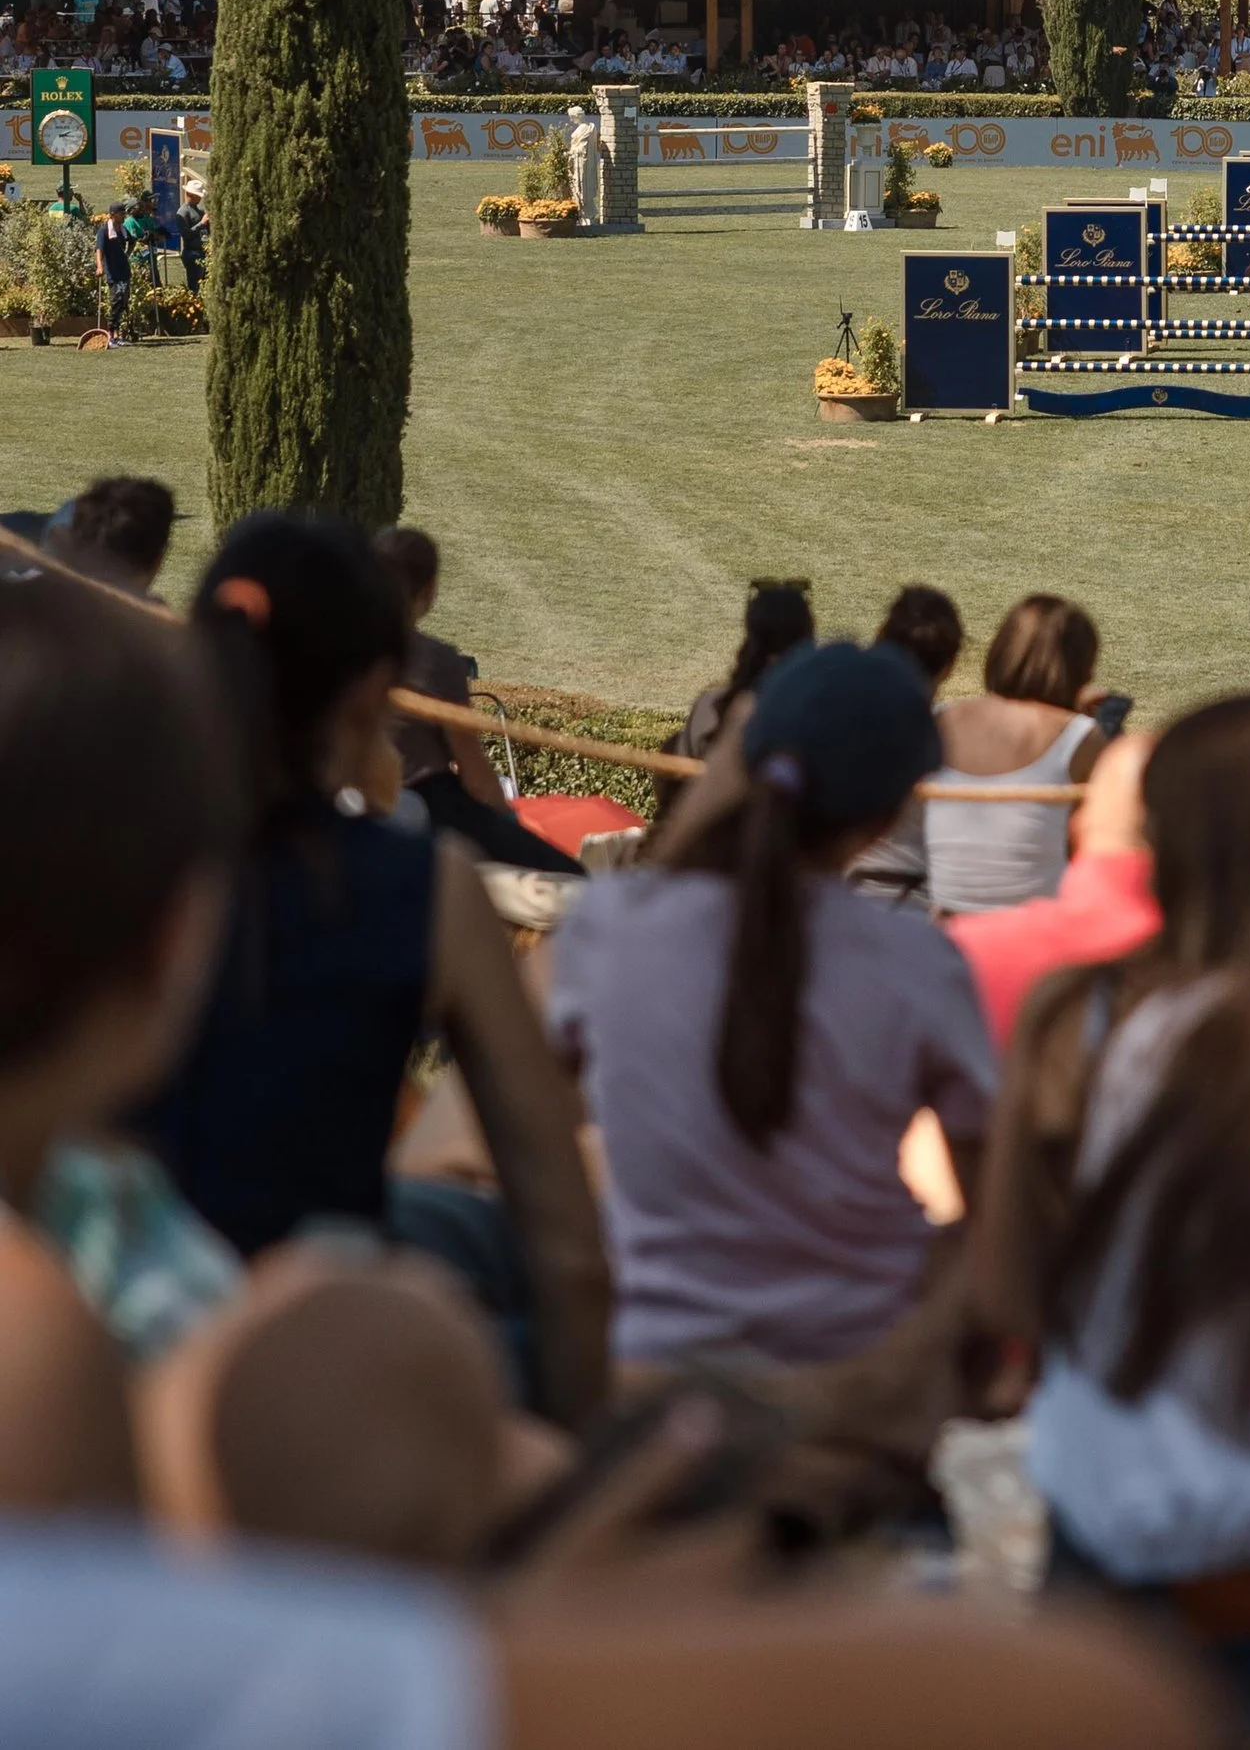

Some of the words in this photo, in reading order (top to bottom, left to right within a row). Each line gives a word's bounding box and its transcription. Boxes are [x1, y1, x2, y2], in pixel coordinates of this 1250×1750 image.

[41, 91, 83, 101] ROLEX
[5, 114, 32, 148] 10
[481, 118, 545, 150] 100
[945, 123, 1006, 155] 100
[1051, 125, 1106, 157] eni
[1170, 126, 1232, 158] 100
[859, 214, 868, 229] 15
[1054, 248, 1091, 268] Loro
[1092, 246, 1134, 268] Piana
[913, 297, 955, 320] Loro
[955, 296, 1001, 321] Piana
